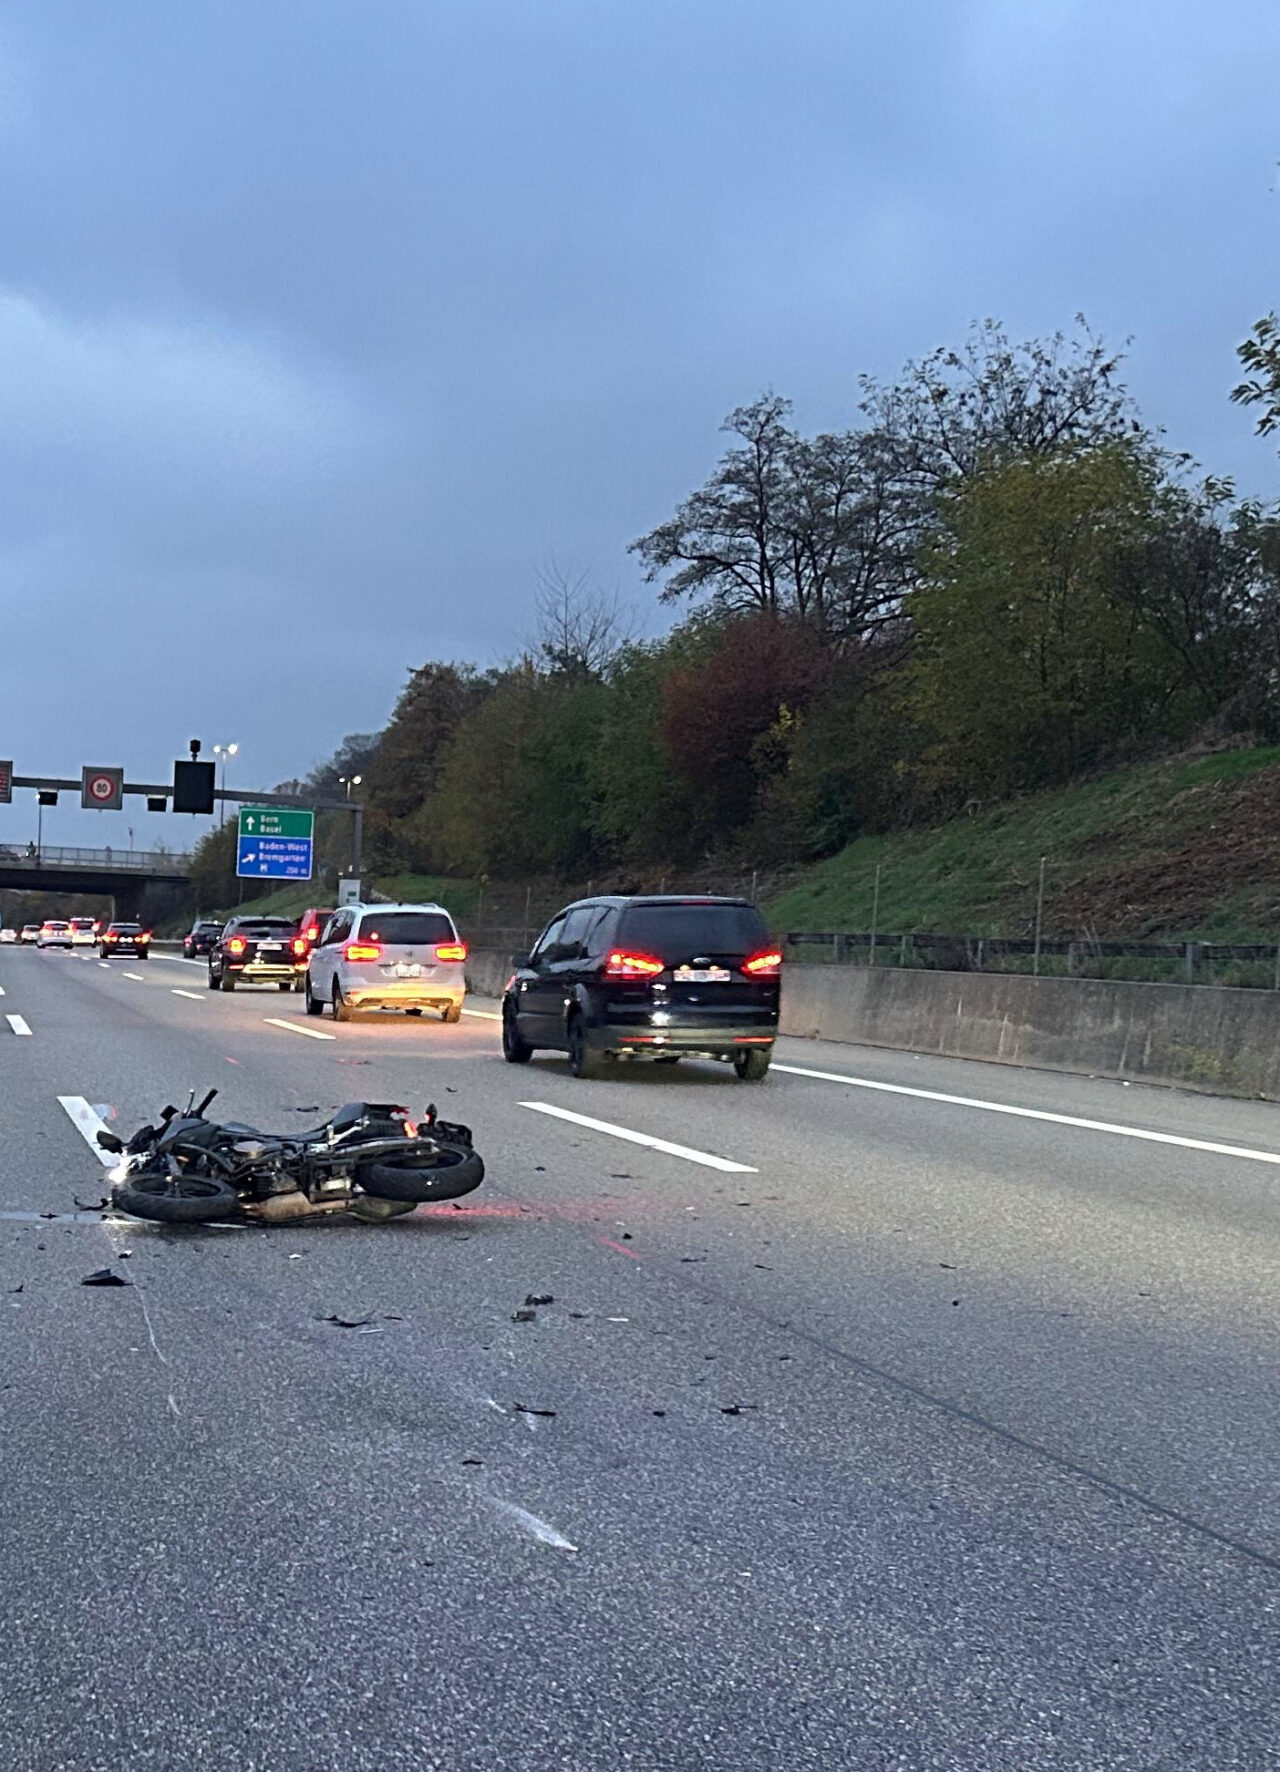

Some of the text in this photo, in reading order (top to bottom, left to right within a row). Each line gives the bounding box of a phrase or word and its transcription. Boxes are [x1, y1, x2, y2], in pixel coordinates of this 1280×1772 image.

[95, 782, 109, 794] 80
[260, 815, 279, 823] Bern
[260, 825, 282, 833] Basel
[259, 841, 308, 852] Baden-West
